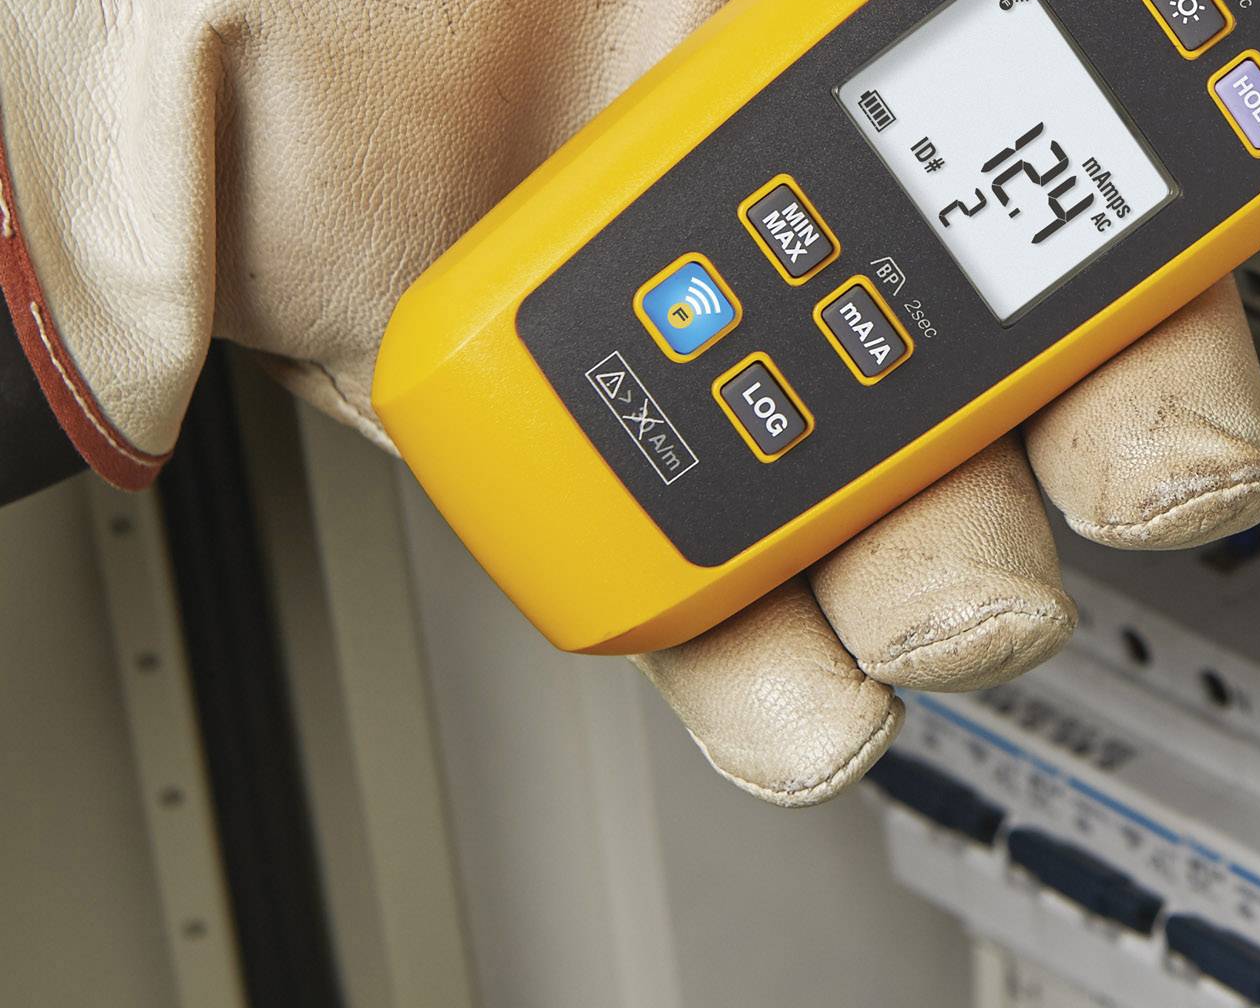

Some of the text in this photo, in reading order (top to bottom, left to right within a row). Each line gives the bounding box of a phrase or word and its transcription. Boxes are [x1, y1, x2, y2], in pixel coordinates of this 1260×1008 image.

[910, 136, 946, 174] ID#
[980, 121, 1095, 245] 12.4
[1081, 156, 1132, 220] mAmps
[781, 201, 820, 248] MIN
[938, 187, 988, 228] 2
[1090, 211, 1112, 234] AC
[761, 209, 808, 264] MAX
[875, 263, 899, 286] BP
[838, 301, 892, 366] mA/A
[903, 299, 938, 339] 2sec
[741, 381, 789, 438] LOG
[648, 434, 681, 471] A/m
